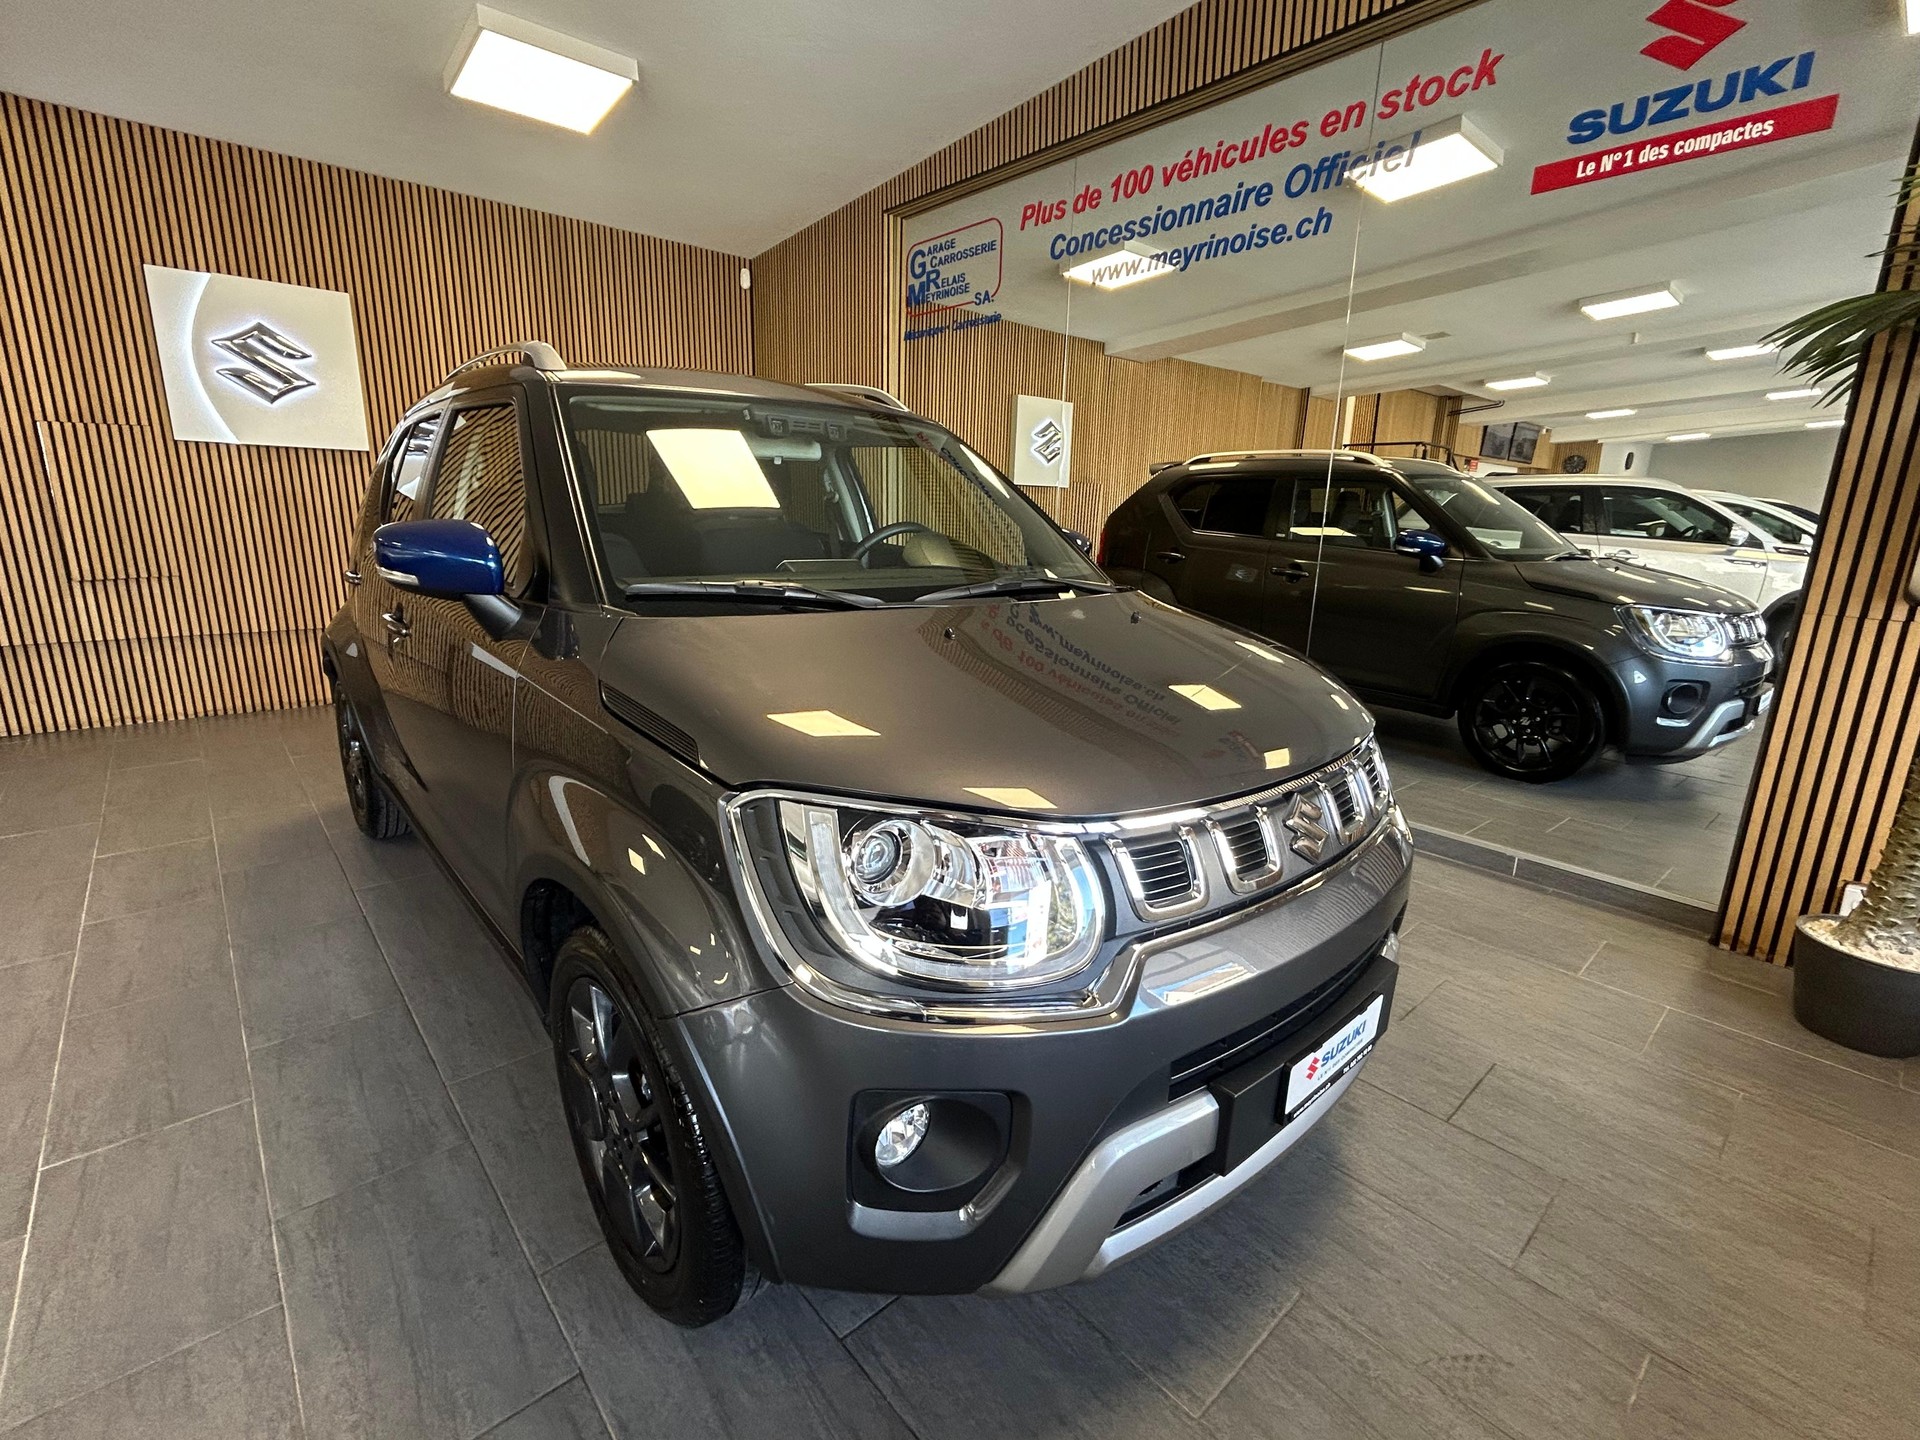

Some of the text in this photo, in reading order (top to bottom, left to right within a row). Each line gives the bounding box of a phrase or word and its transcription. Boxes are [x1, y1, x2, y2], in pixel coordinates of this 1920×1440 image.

[1566, 50, 1816, 145] SUZUKI
[1020, 47, 1505, 231] Plus de 100 véhicules en stock
[1576, 159, 1595, 179] Le
[1638, 141, 1669, 165] des
[1674, 118, 1775, 156] compactes
[1050, 129, 1425, 261] Concessionnaire Officiel
[910, 238, 956, 279] GARAGE
[930, 240, 997, 269] CARROSSERIE
[1092, 206, 1334, 284] www.meyrinoise.ch
[907, 281, 970, 307] MEYRINOISE
[926, 269, 966, 292] RELAIS
[1321, 1020, 1367, 1067] SUZUKI
